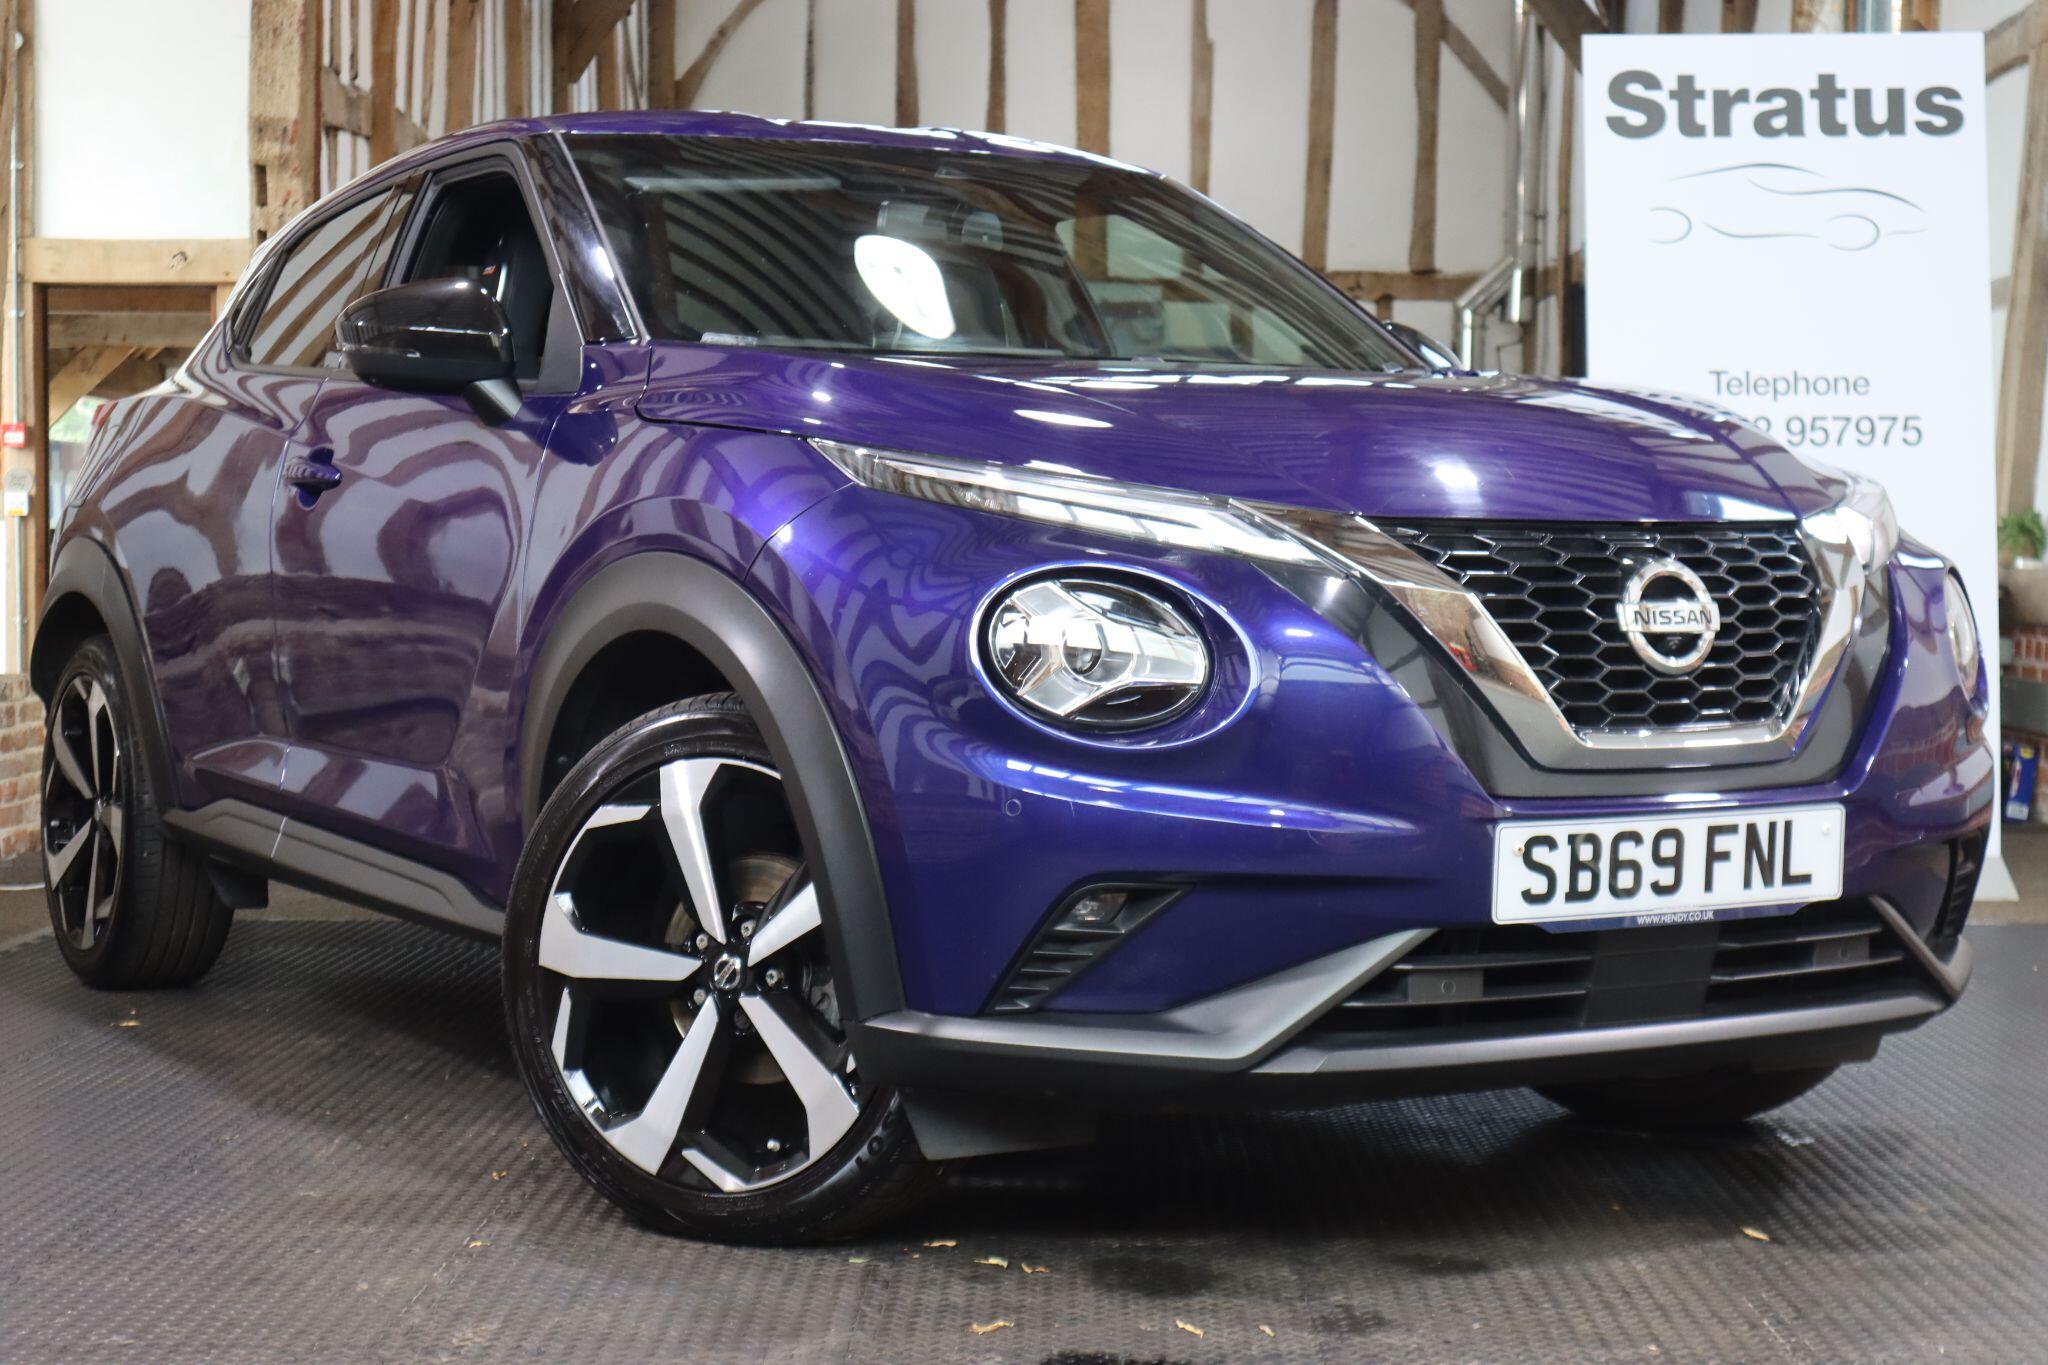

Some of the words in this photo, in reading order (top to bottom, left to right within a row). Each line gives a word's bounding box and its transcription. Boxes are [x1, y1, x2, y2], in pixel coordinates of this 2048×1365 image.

[1606, 69, 1964, 139] Stratus
[1708, 370, 1870, 401] Telephone
[1786, 415, 1923, 446] 957975
[1634, 609, 1712, 625] NISSAN
[1520, 827, 1686, 906] SB69
[1704, 819, 1812, 894] FNL
[1636, 911, 1714, 926] WWW.HENDY.CO.UK
